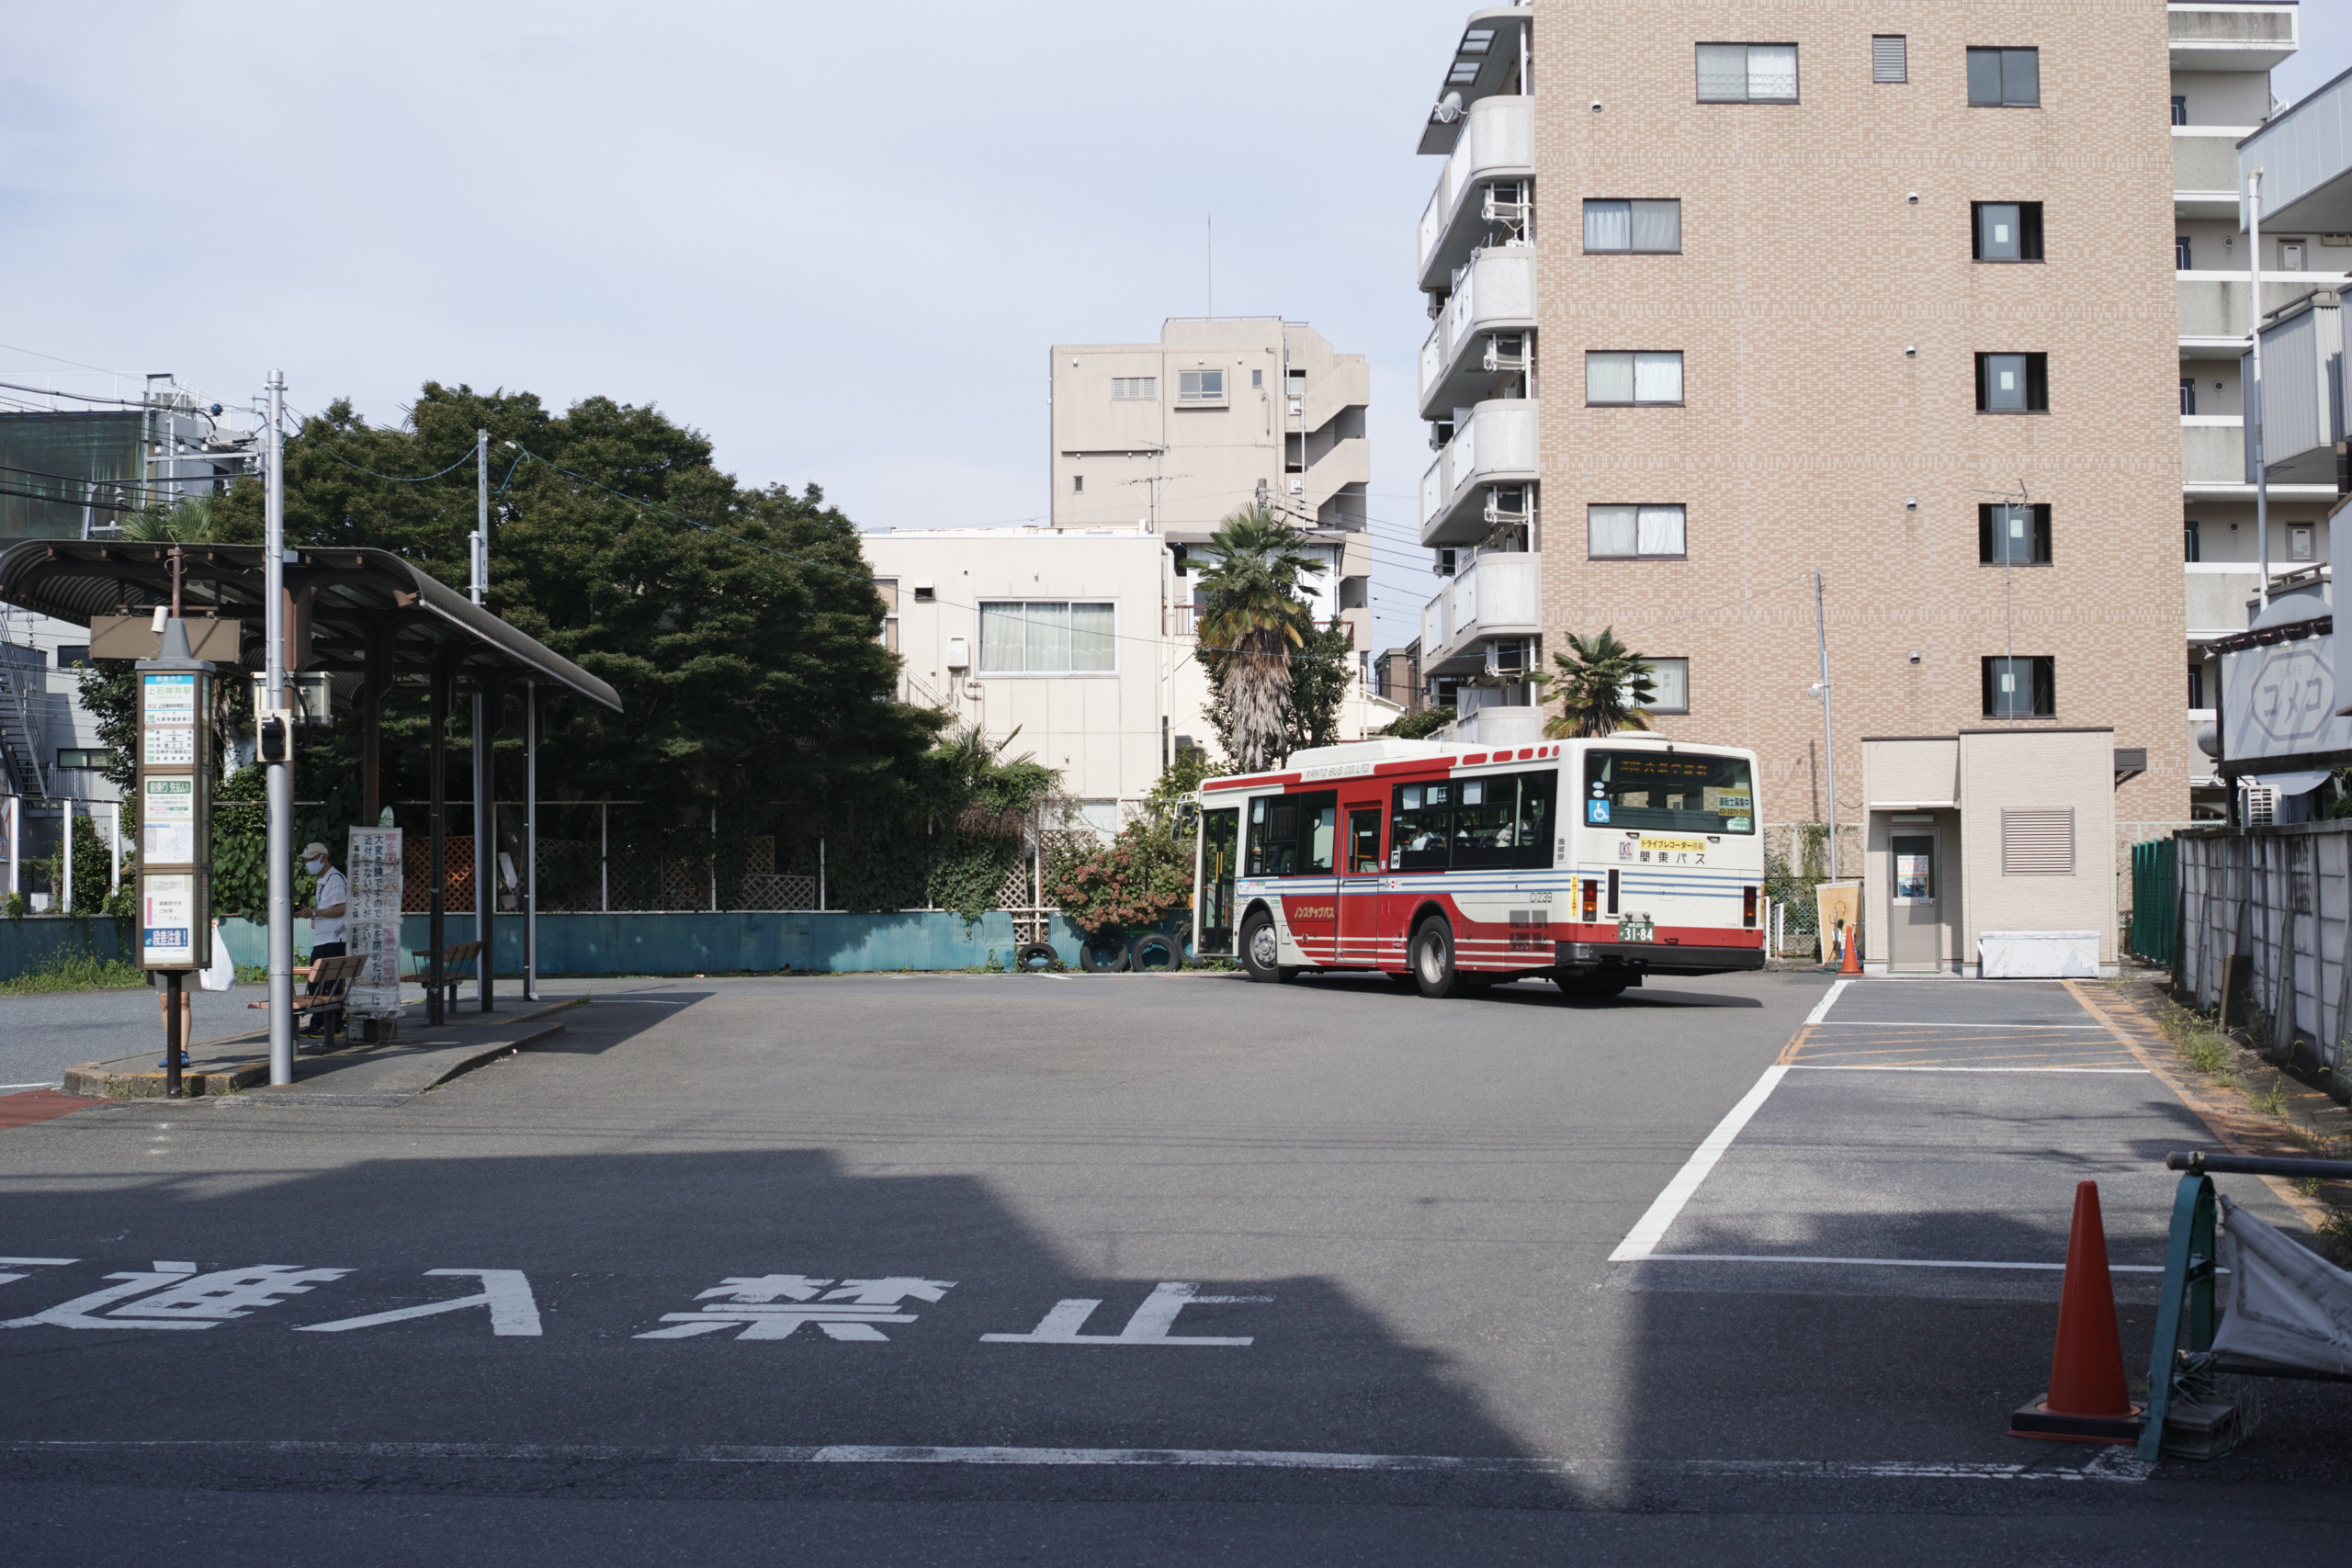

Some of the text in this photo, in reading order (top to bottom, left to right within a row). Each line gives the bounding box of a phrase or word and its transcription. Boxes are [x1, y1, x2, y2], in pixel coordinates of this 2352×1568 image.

[2279, 665, 2303, 678] CAFE
[147, 686, 192, 695] 上石神井駅
[2264, 677, 2323, 724] コメコ
[1306, 768, 1328, 779] KANTO
[1329, 766, 1343, 777] BUS
[1718, 796, 1750, 807] 運転士募集中
[1640, 851, 1705, 865] 関東バス
[1294, 907, 1335, 919] ノンステップバス
[0, 1258, 1277, 1347] 進入禁止
